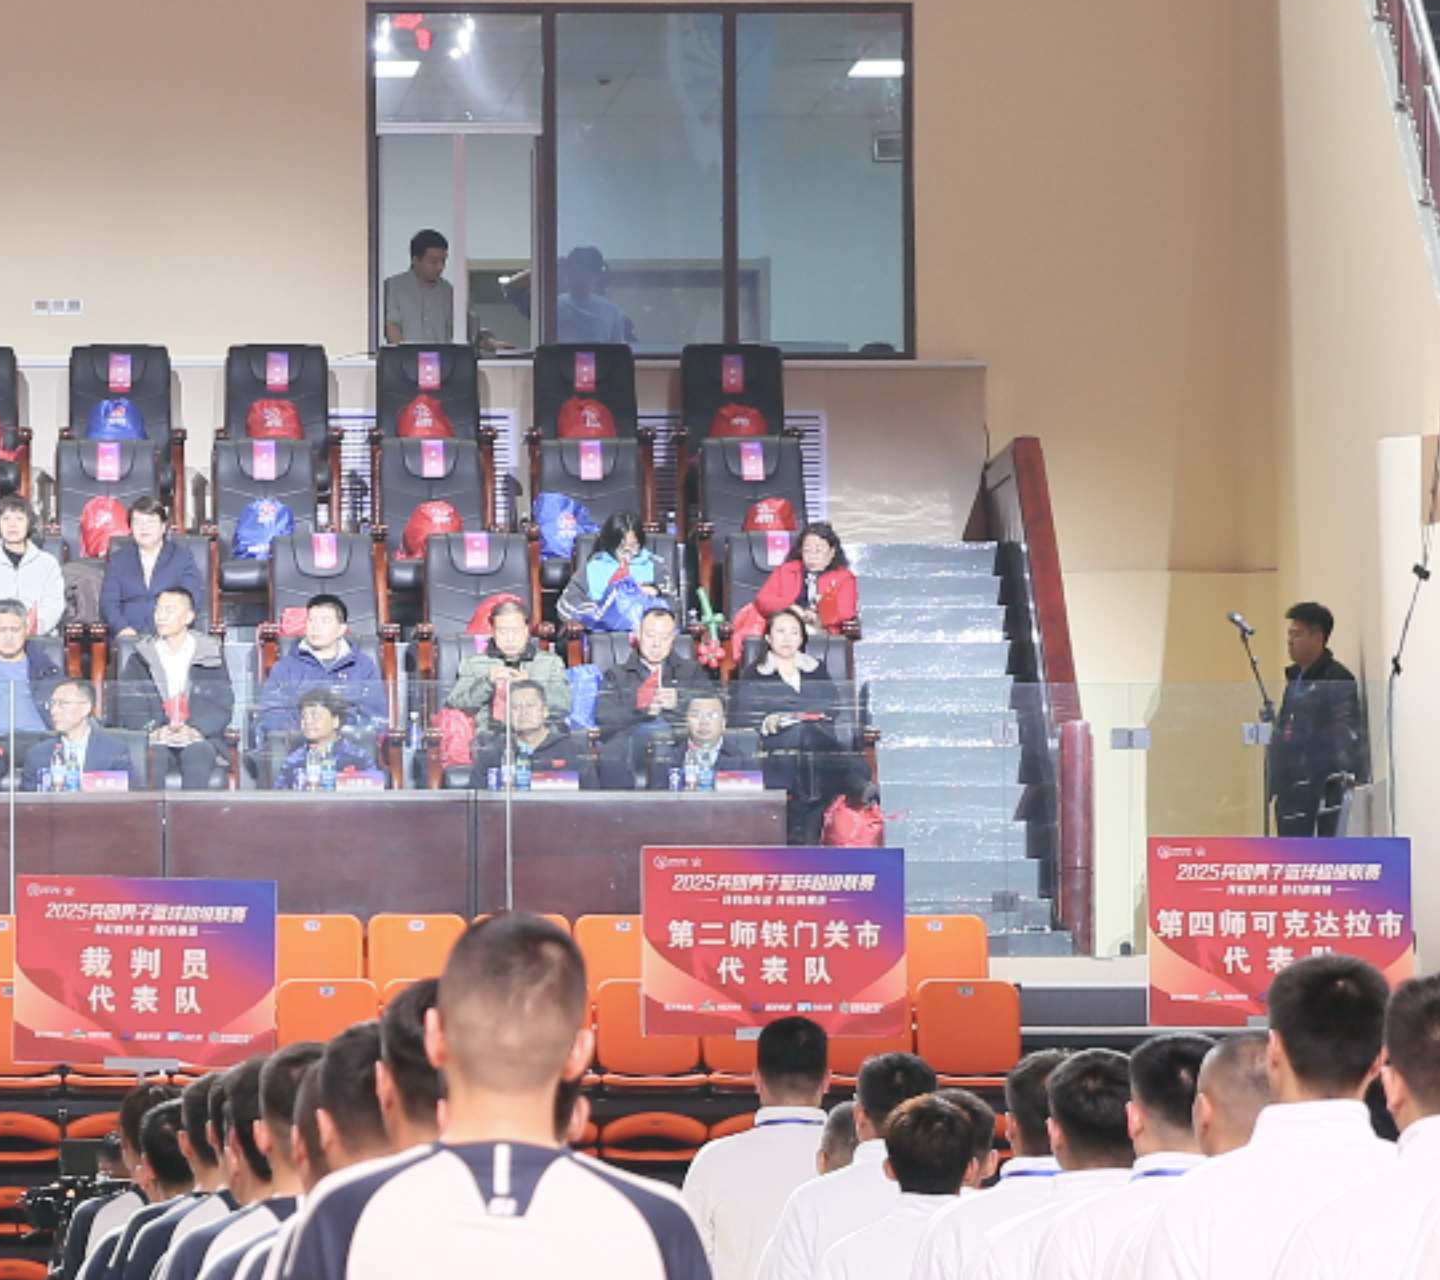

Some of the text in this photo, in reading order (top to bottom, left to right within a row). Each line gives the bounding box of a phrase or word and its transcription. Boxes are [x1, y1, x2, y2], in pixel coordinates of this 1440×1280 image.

[667, 919, 882, 949] 第二师铁门关市
[1157, 909, 1404, 939] 第四师可克达拉市
[79, 945, 210, 980] 裁判员
[716, 955, 832, 985] 代表队
[87, 985, 202, 1015] 代表队
